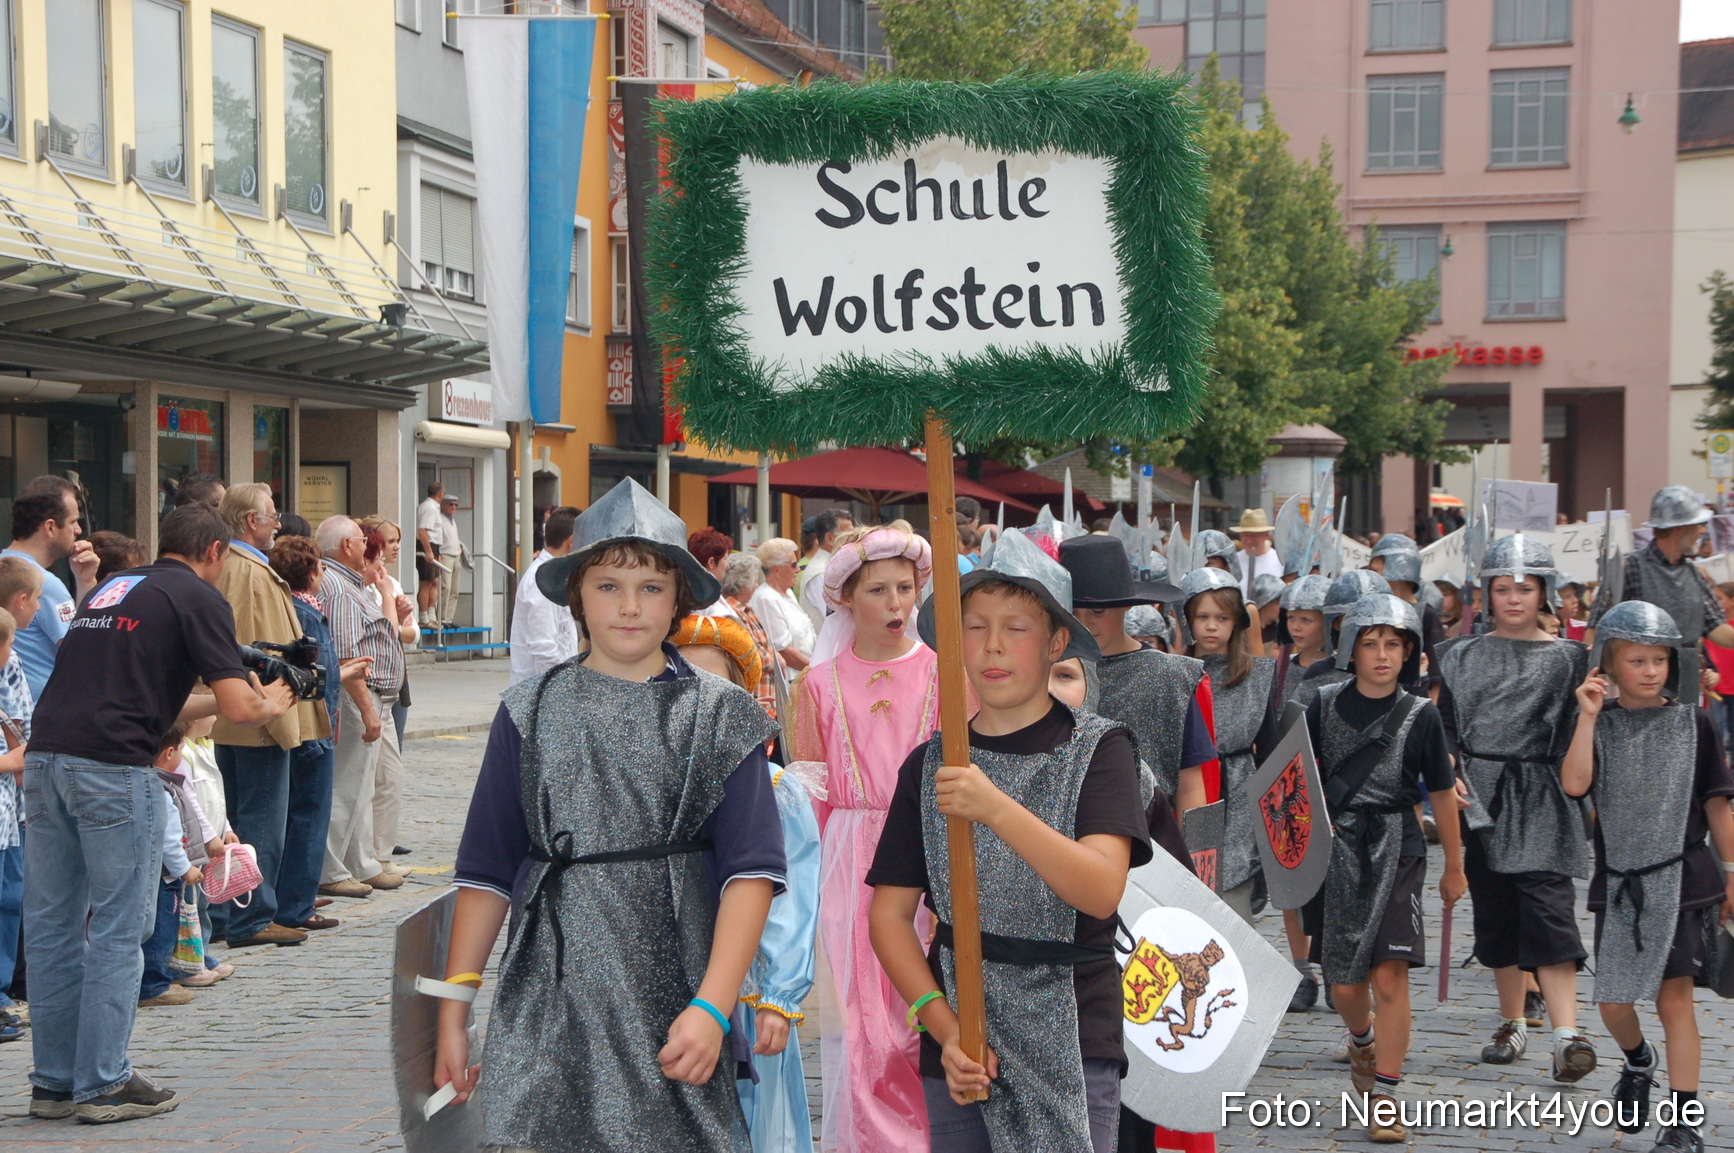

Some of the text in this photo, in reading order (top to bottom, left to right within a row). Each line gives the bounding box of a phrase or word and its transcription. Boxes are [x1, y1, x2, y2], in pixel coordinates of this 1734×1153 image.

[815, 158, 1049, 228] Schule
[773, 261, 1105, 336] Wolfstein
[1401, 342, 1544, 367] parkasse
[70, 615, 139, 632] eumarkt TV
